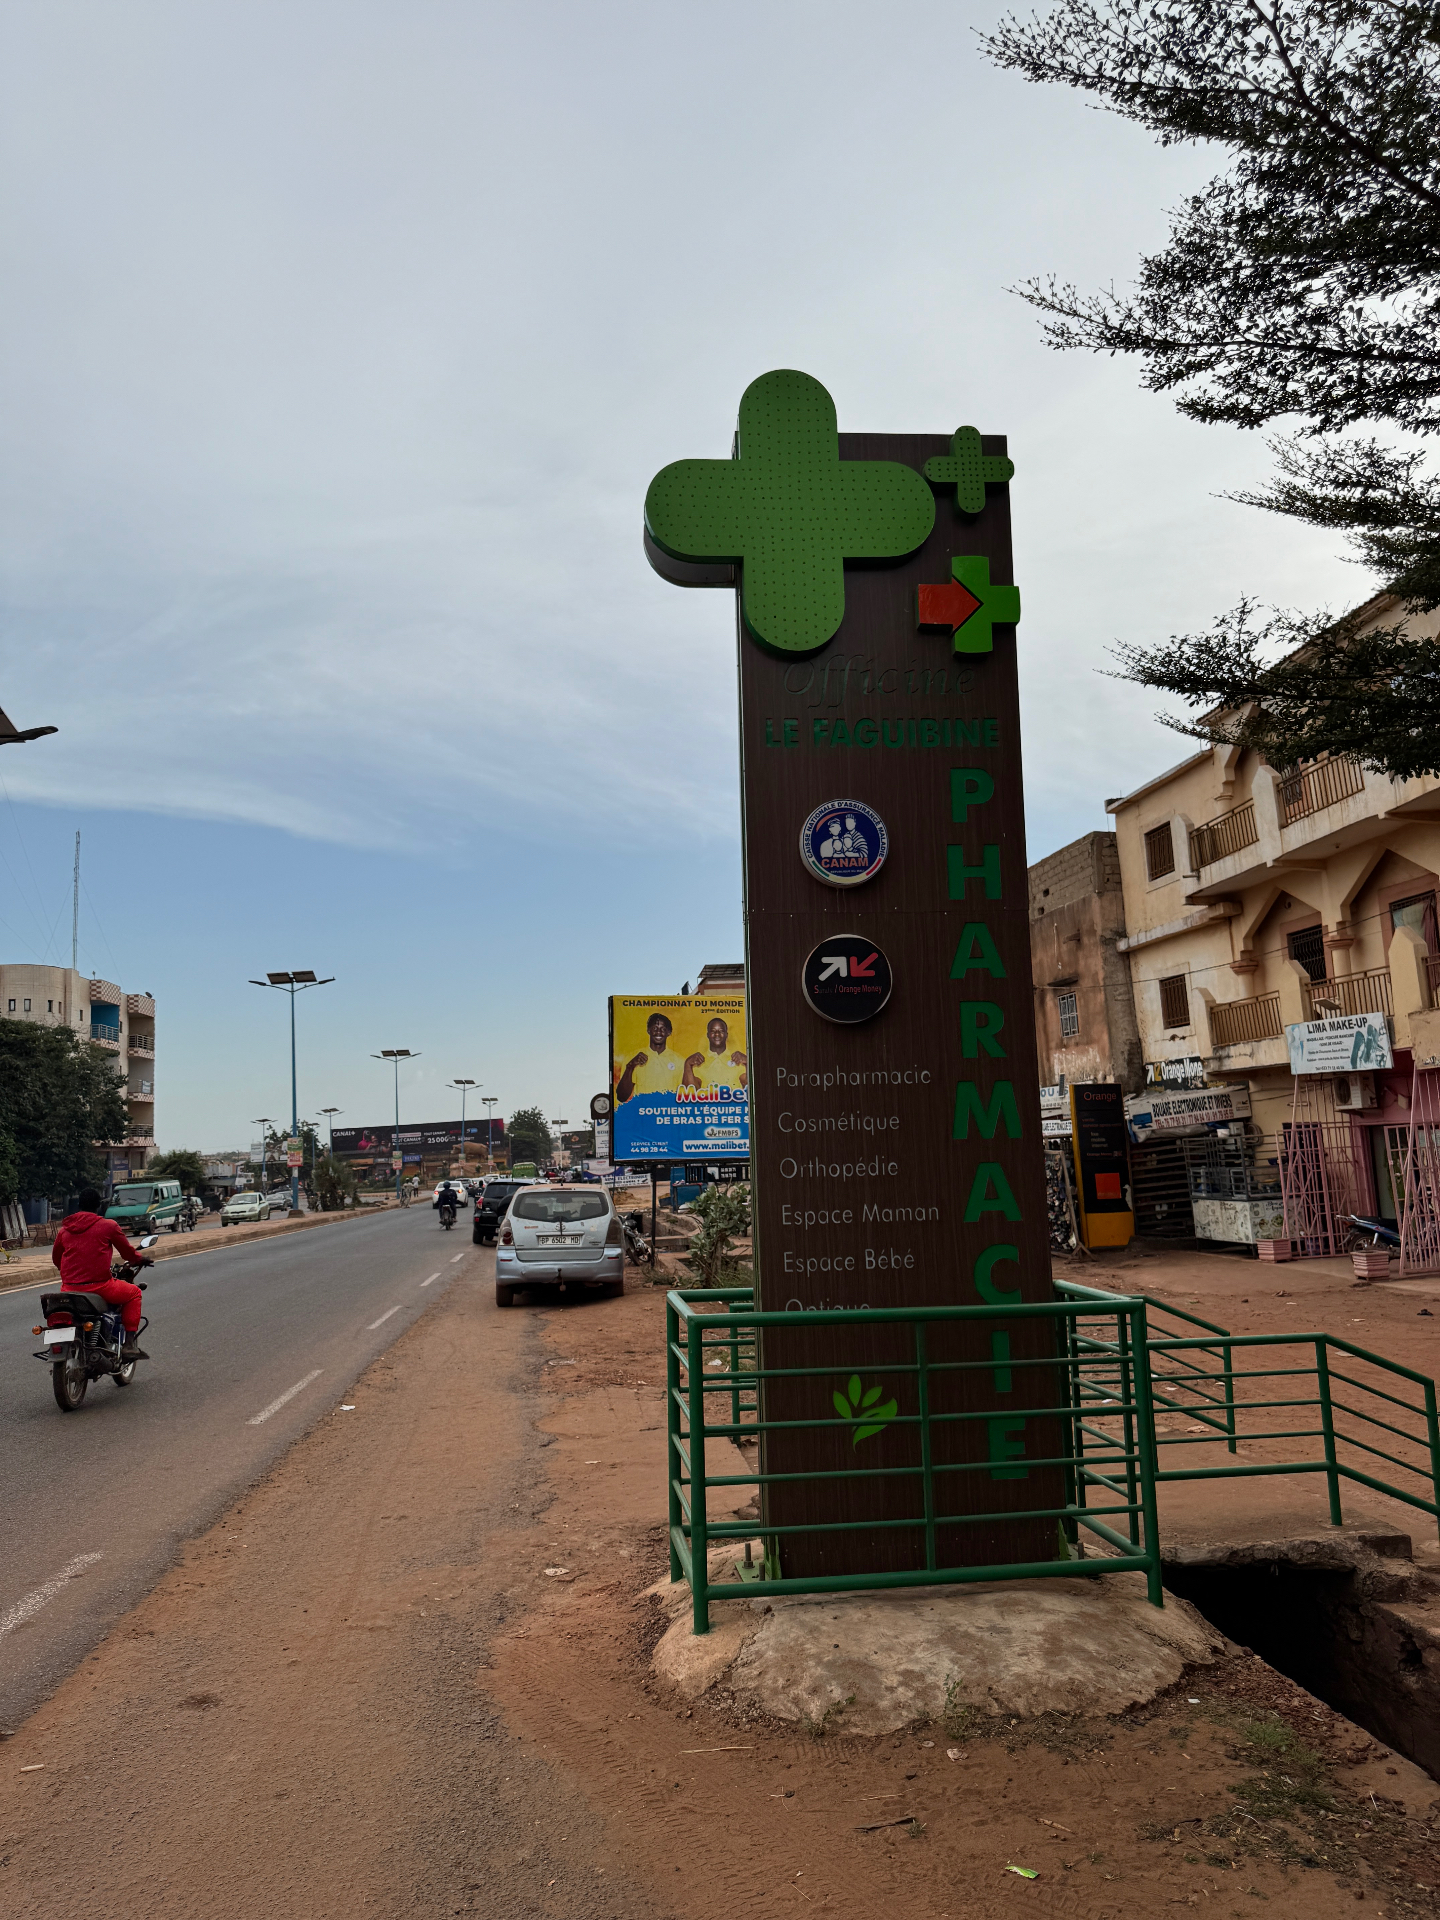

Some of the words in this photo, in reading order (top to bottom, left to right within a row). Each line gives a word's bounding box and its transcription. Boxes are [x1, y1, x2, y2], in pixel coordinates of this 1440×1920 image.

[783, 654, 976, 709] Officine
[765, 717, 799, 749] LE
[813, 717, 999, 749] FAGUIBINE
[807, 803, 836, 832] NATIONALE
[804, 833, 814, 858] CAISSE
[877, 825, 887, 858] MALADIE
[821, 857, 869, 868] CANAM
[839, 985, 861, 994] Orange
[862, 984, 882, 994] Money
[1306, 1022, 1328, 1034] LIMA
[1328, 1017, 1368, 1032] MAKE-UP
[1160, 1062, 1184, 1084] Orange
[1084, 1092, 1116, 1102] Orange
[638, 1107, 692, 1116] SOUTIENT
[694, 1105, 742, 1116] L'ÉQUIPE
[656, 1116, 671, 1124] DE
[673, 1116, 702, 1124] BRAS
[704, 1116, 719, 1124] DE
[721, 1115, 741, 1123] FER
[778, 1111, 900, 1136] Cosmétique
[947, 768, 1029, 1480] PHARMACIE
[780, 1155, 898, 1182] Orthopédie
[782, 1204, 853, 1230] Espace
[862, 1203, 939, 1222] Maman
[784, 1251, 855, 1277] Espace
[865, 1248, 915, 1270] Bébé
